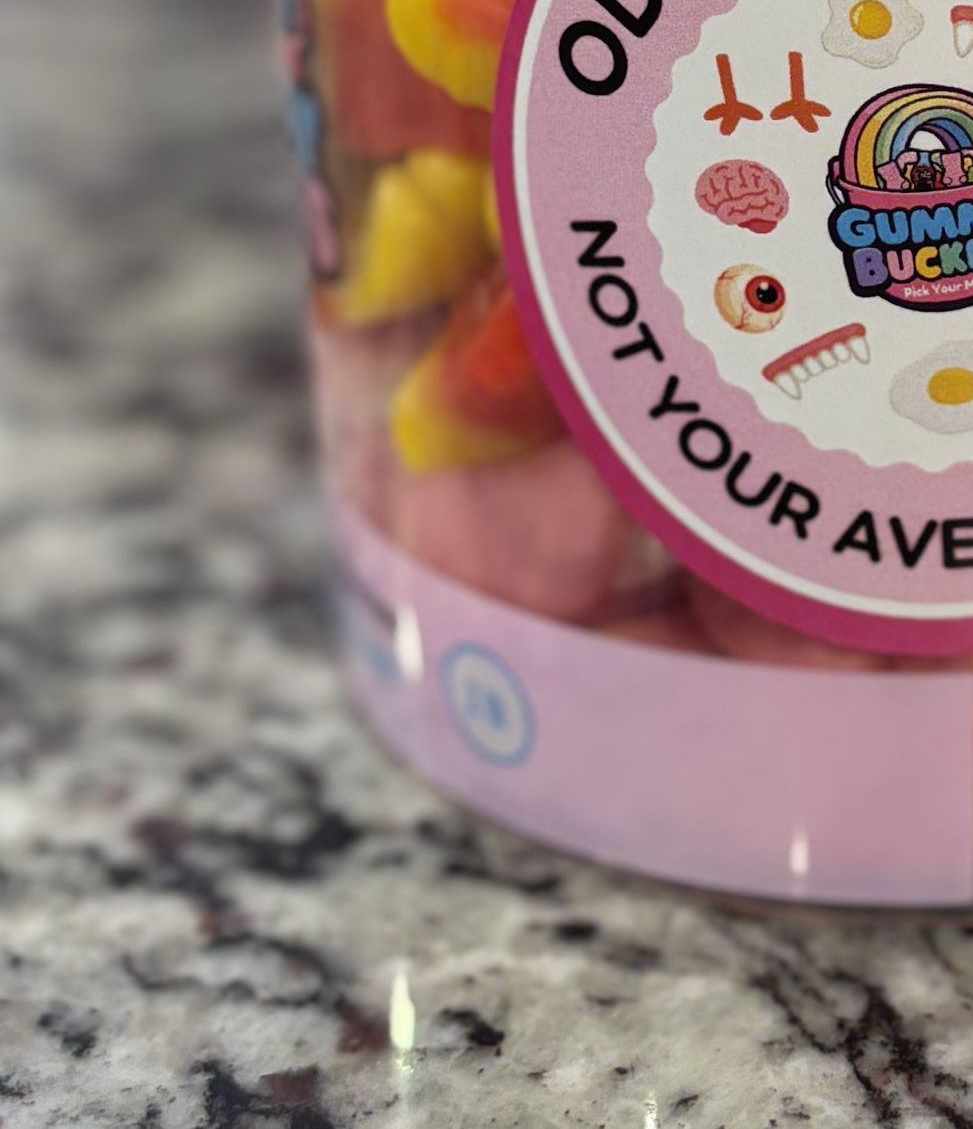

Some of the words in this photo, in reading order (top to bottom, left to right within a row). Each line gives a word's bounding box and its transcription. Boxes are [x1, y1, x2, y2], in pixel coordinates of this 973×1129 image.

[904, 285, 930, 298] Pick
[931, 283, 963, 294] Your
[569, 219, 666, 364] NOT
[648, 374, 821, 541] YOUR
